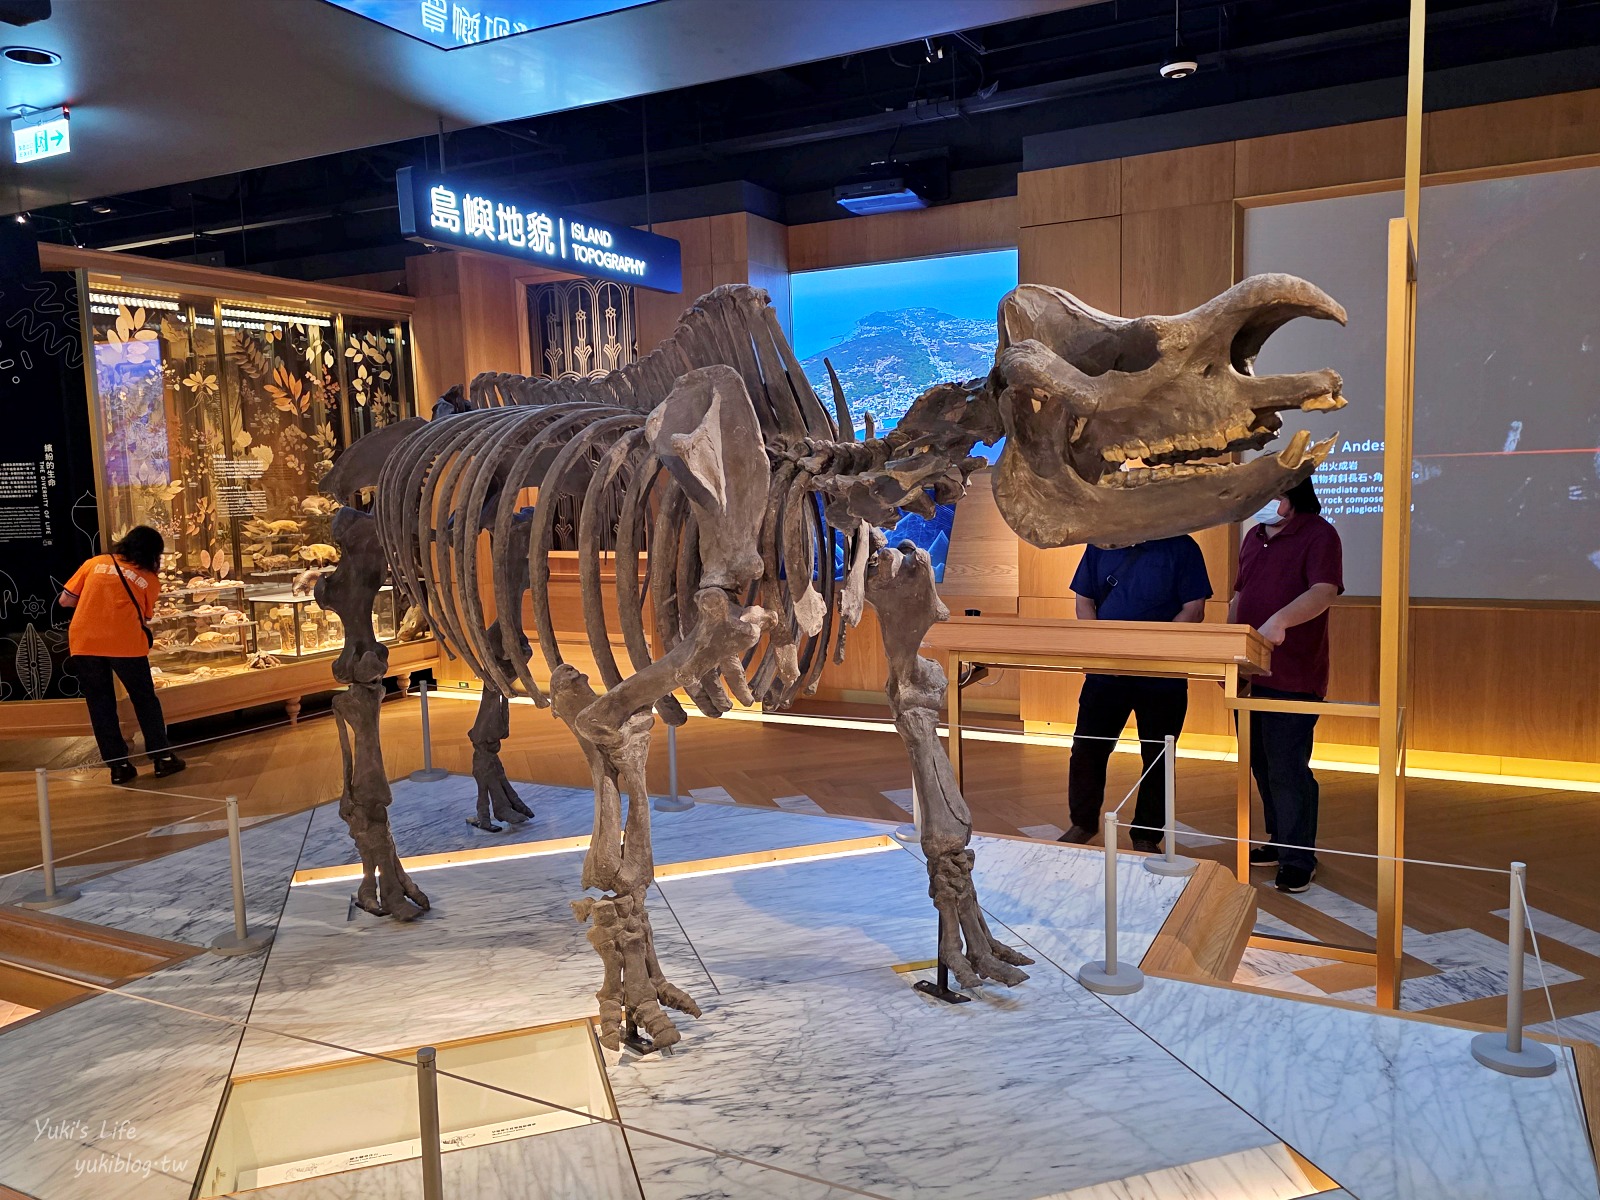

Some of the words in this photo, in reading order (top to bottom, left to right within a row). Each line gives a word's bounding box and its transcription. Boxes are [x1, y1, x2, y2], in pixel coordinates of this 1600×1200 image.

[430, 185, 555, 255] 島嶼地貌
[571, 222, 612, 248] ISLAND
[572, 243, 646, 276] TOPOGRAPHY
[1341, 439, 1384, 453] Andes
[1323, 496, 1343, 504] rock
[1344, 496, 1384, 505] compose
[1334, 505, 1344, 514] of
